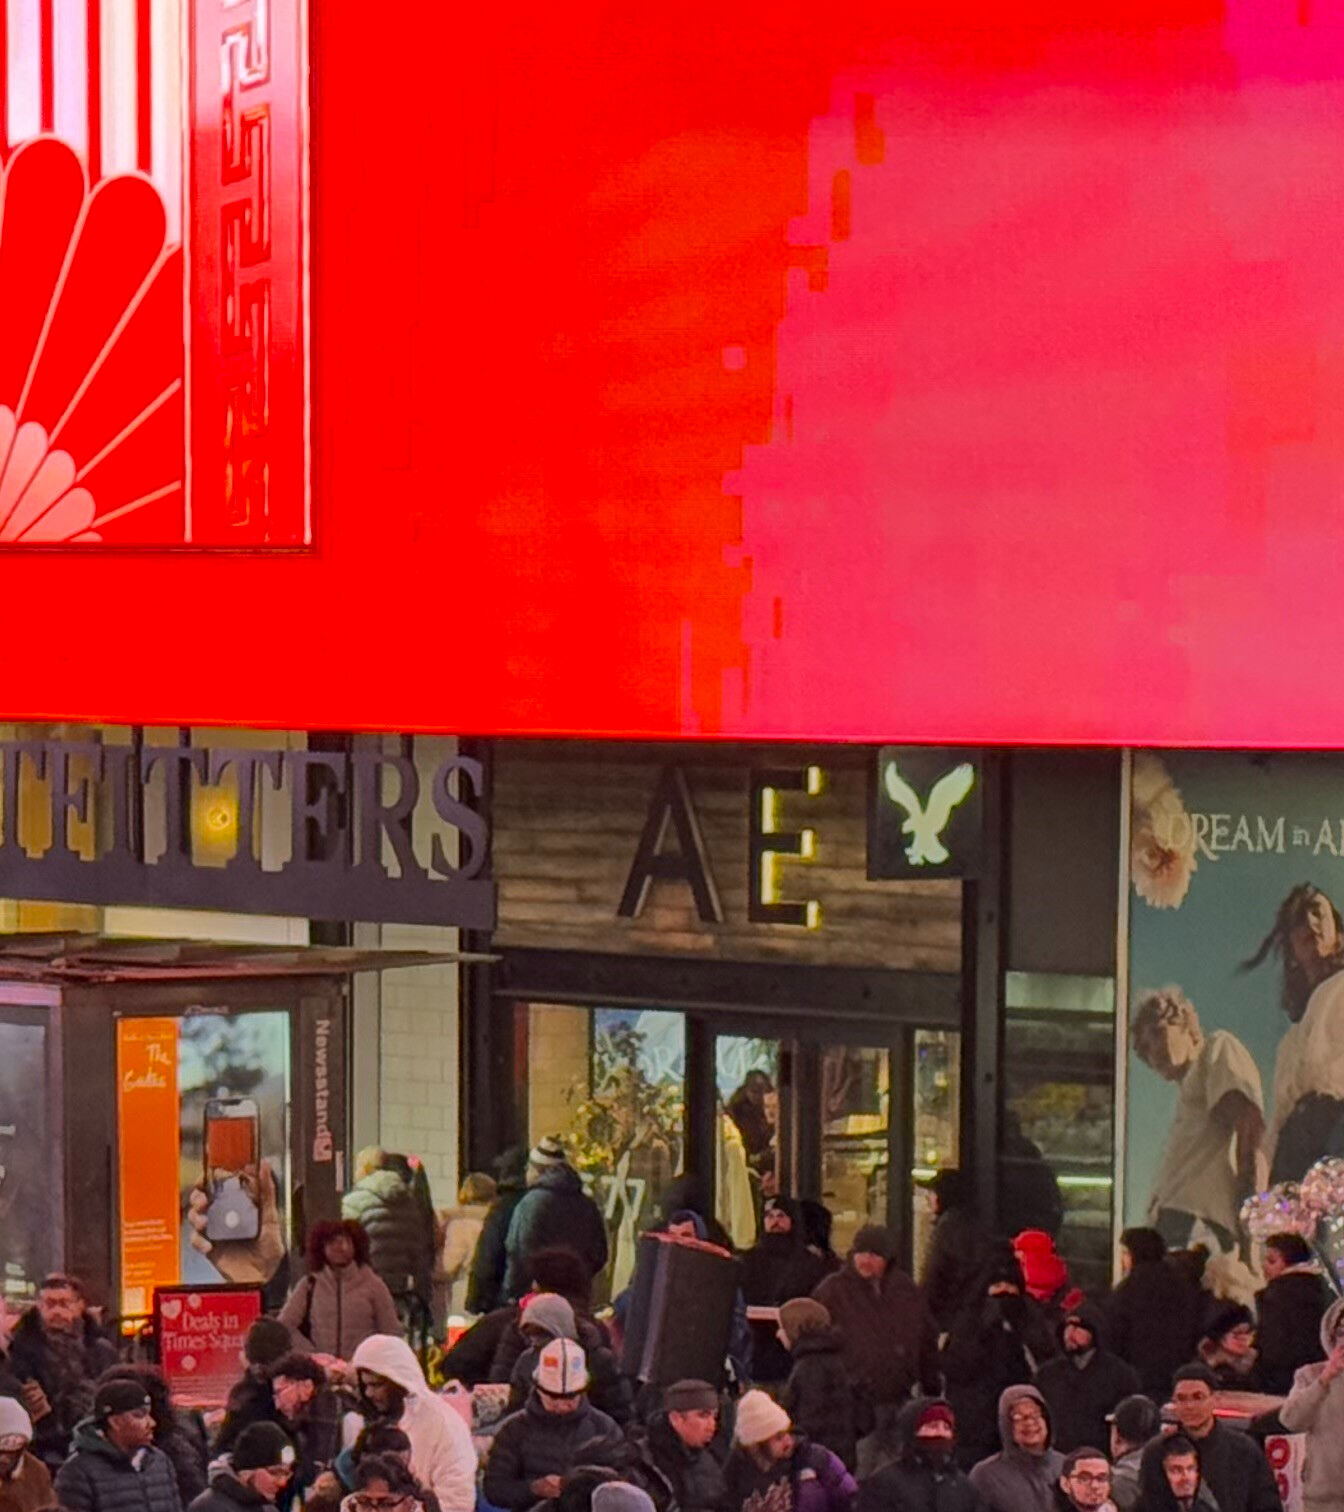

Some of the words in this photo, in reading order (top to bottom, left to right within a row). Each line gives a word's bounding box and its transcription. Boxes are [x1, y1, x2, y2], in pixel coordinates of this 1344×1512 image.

[617, 765, 826, 930] AE
[315, 1018, 331, 1139] Newsstand
[163, 1331, 207, 1352] Times
[208, 1331, 246, 1353] Squa
[182, 1310, 221, 1332] Deals
[222, 1311, 239, 1330] in
